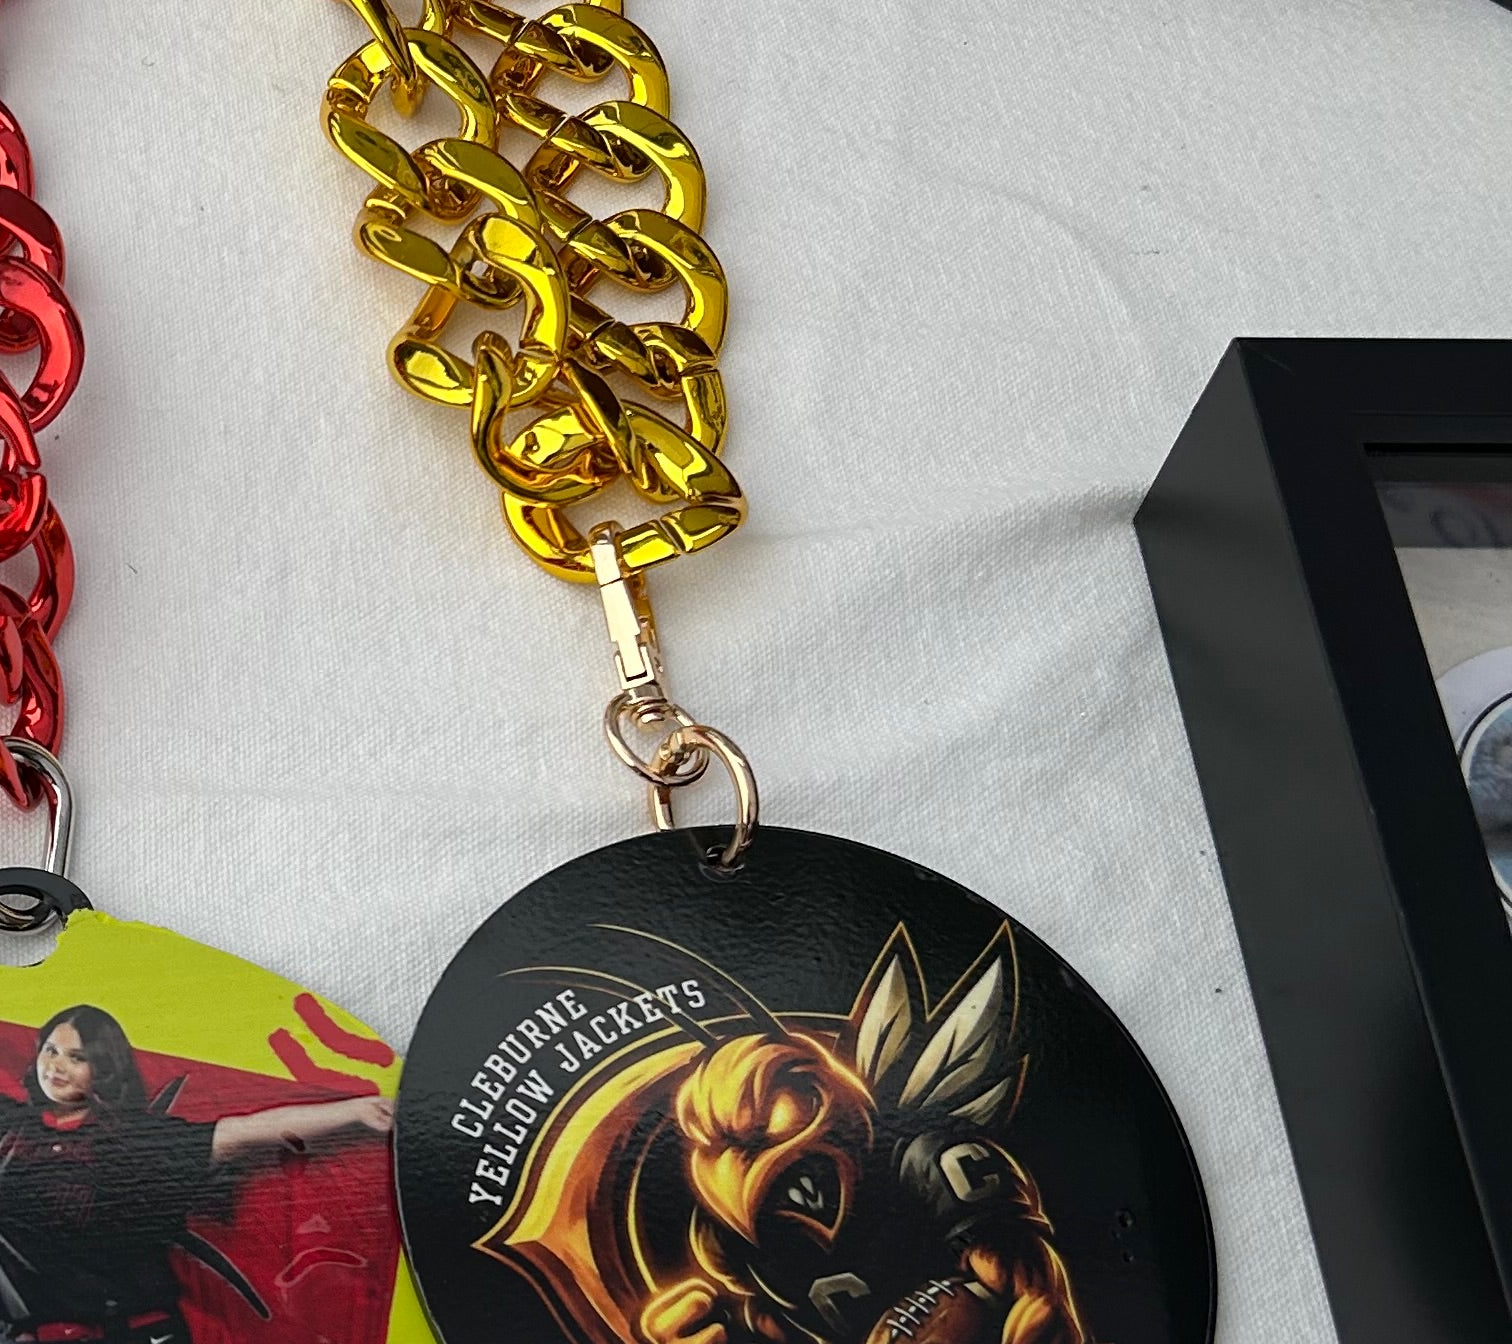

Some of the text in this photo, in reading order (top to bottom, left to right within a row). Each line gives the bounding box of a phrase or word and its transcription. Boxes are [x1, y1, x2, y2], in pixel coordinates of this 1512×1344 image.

[450, 988, 588, 1139] CLEBURNE
[468, 979, 706, 1206] YELLOW JACKETS
